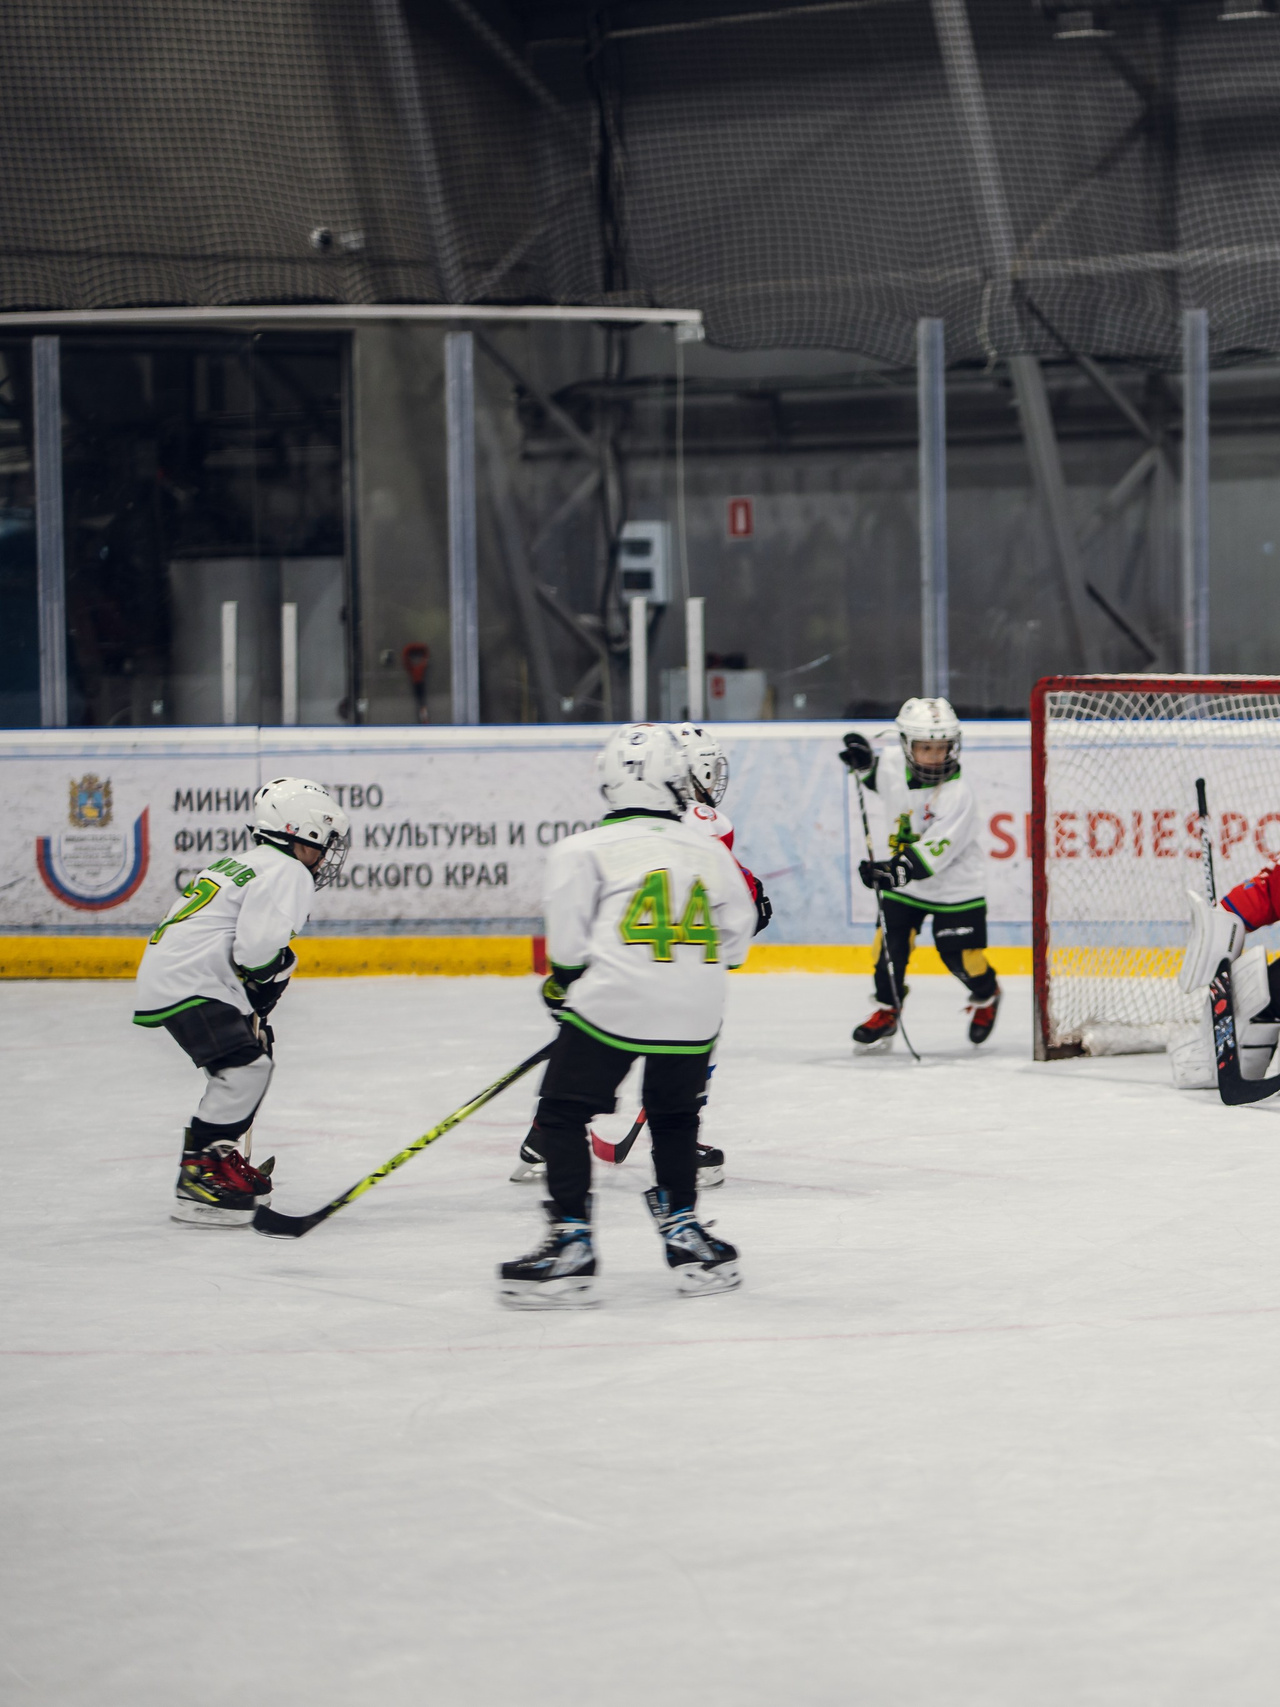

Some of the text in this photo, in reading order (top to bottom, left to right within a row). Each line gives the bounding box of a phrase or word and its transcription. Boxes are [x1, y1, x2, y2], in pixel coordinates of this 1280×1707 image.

[364, 820, 497, 848] КУЛЬТУРЫ
[508, 821, 525, 846] И
[444, 861, 509, 887] КРАЯ
[619, 867, 722, 964] 44
